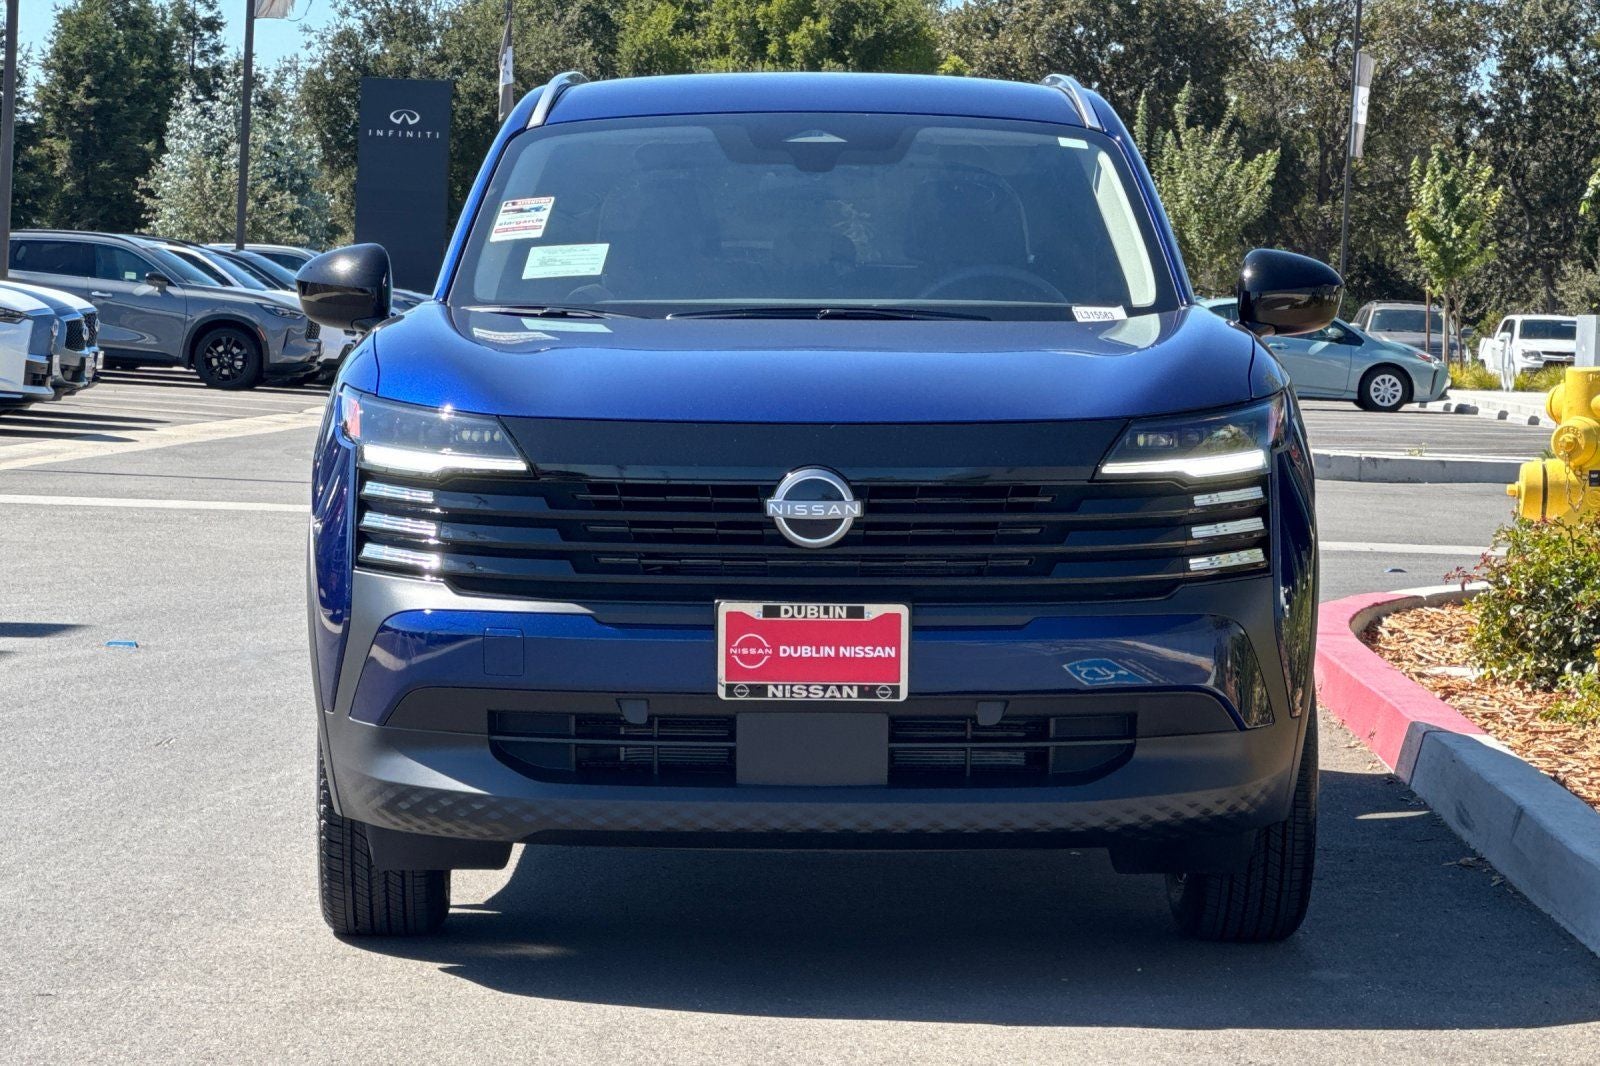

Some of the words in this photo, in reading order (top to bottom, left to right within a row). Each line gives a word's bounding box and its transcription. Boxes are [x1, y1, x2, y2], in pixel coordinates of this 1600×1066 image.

[369, 129, 439, 139] INFINITI
[769, 503, 859, 516] NISSAN
[779, 605, 847, 619] DUBLIN
[729, 647, 773, 655] NISSAN
[779, 645, 835, 658] DUBLIN
[839, 645, 896, 658] NISSAN
[767, 684, 859, 699] NISSAN
